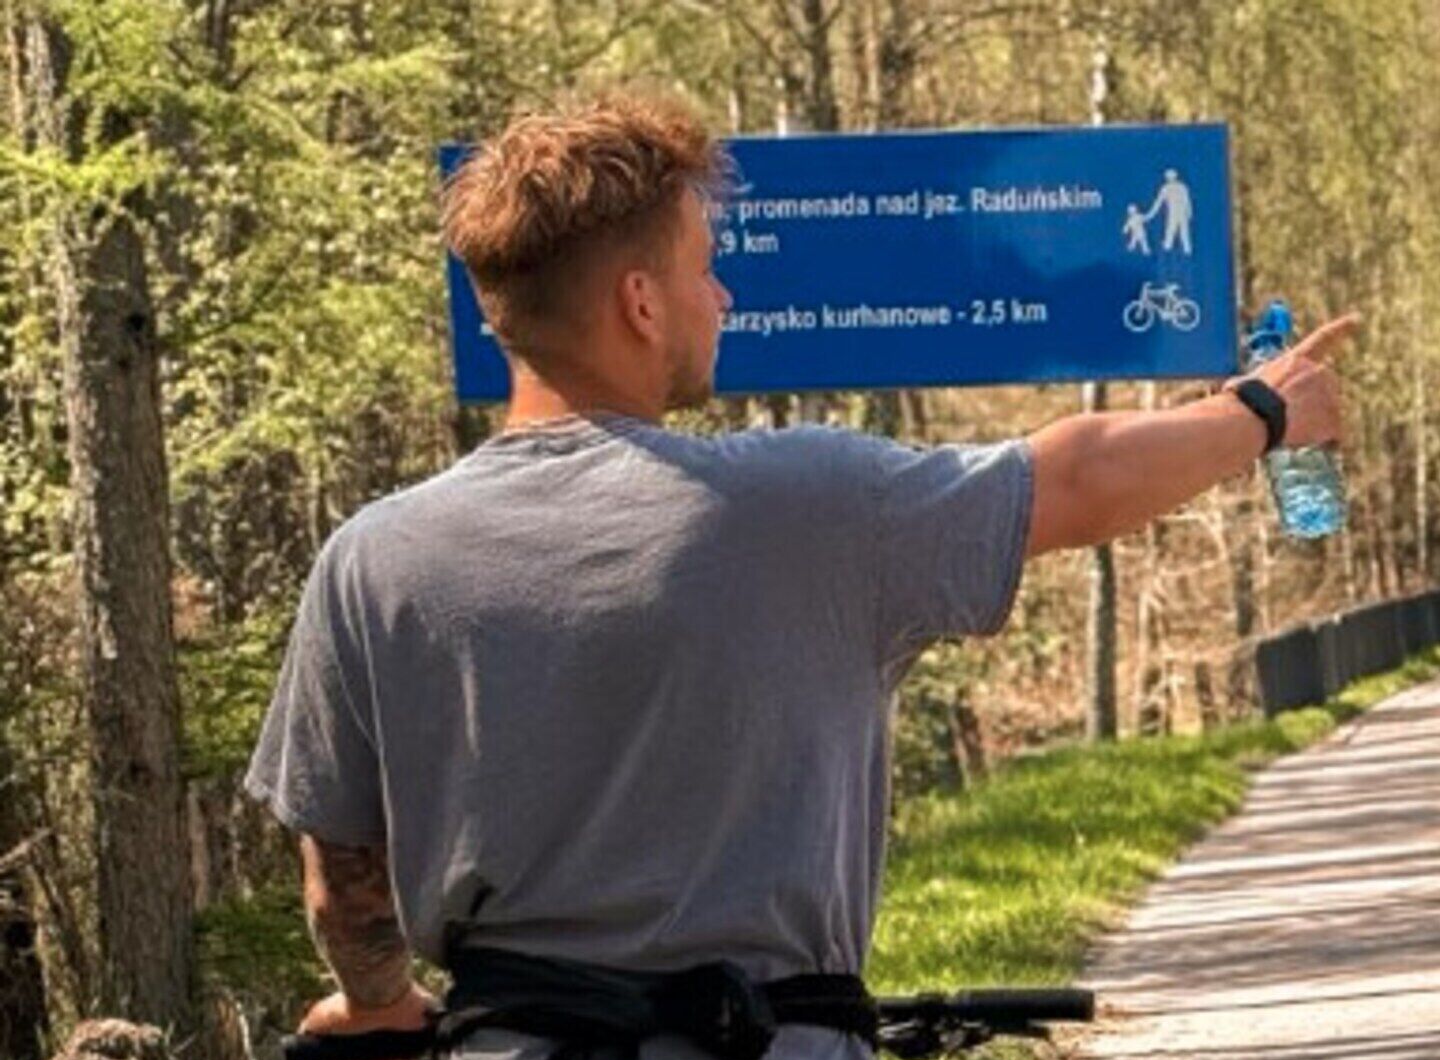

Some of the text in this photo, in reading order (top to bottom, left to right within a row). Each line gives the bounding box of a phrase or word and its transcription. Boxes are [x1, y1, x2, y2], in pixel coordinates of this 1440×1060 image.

[738, 191, 870, 225] promenada
[875, 191, 919, 216] nad
[924, 191, 965, 219] jez.
[971, 185, 1102, 212] Raduńskim
[717, 229, 779, 257] ,9 km
[717, 305, 817, 336] tarzysko
[822, 304, 951, 328] kurhanowe
[971, 300, 1006, 326] 2,5
[1011, 299, 1047, 322] km
